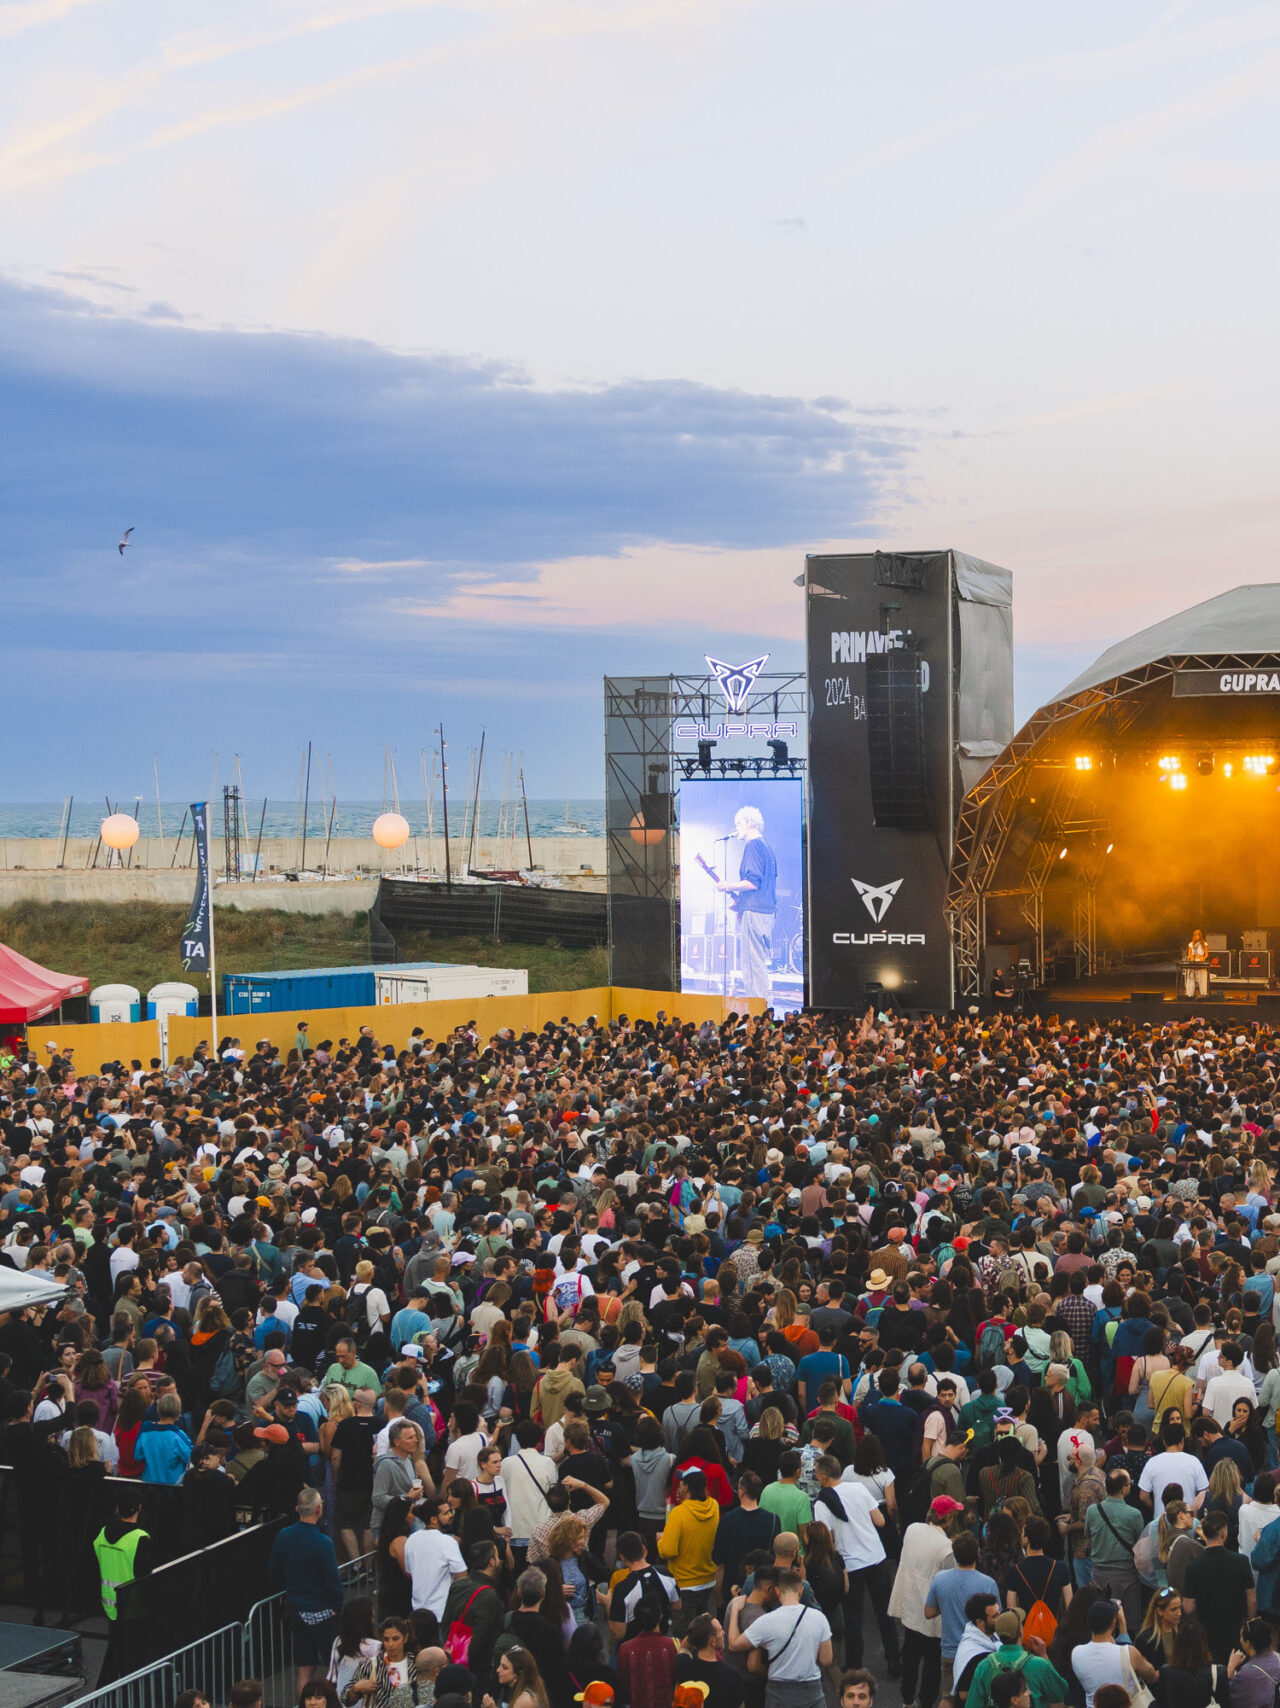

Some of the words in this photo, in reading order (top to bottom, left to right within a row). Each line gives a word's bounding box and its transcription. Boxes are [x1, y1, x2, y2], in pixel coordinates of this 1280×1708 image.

[825, 676, 852, 706] 2024
[1220, 673, 1280, 692] CUPRA
[675, 722, 798, 739] CUPRA
[833, 933, 926, 945] CUPRA
